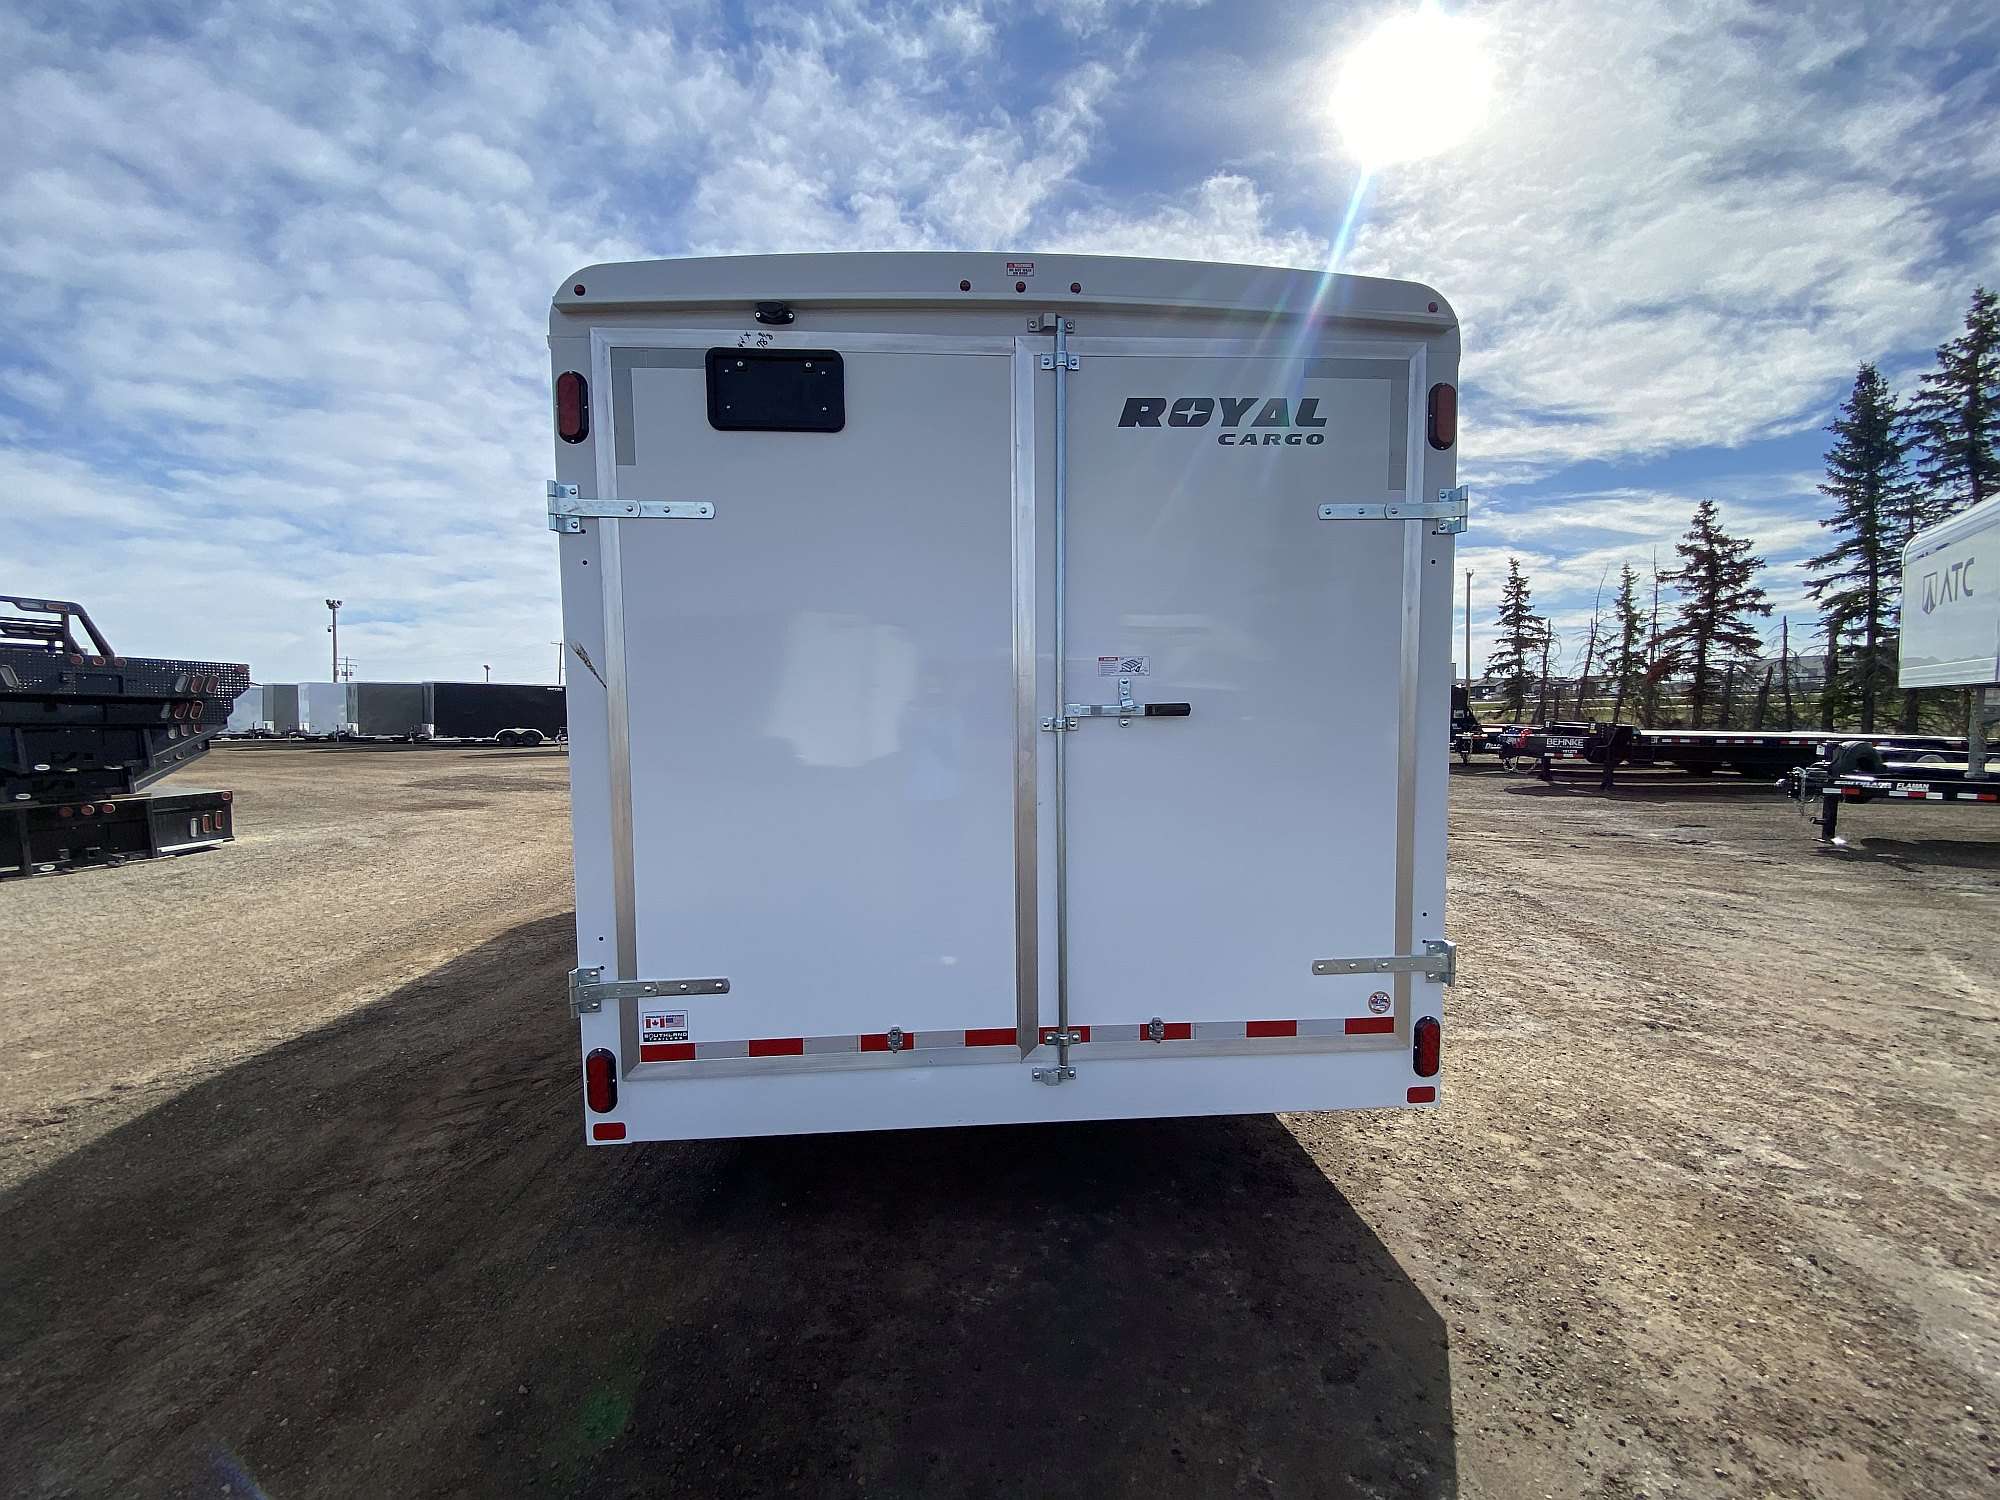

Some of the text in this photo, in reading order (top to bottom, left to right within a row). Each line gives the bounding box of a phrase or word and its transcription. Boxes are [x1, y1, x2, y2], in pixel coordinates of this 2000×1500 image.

[1117, 397, 1328, 428] ROYAL
[1217, 433, 1325, 446] CARGO
[1939, 556, 1975, 606] ATC
[1546, 737, 1584, 747] BEHNKE
[1896, 782, 1930, 790] FLAMAN
